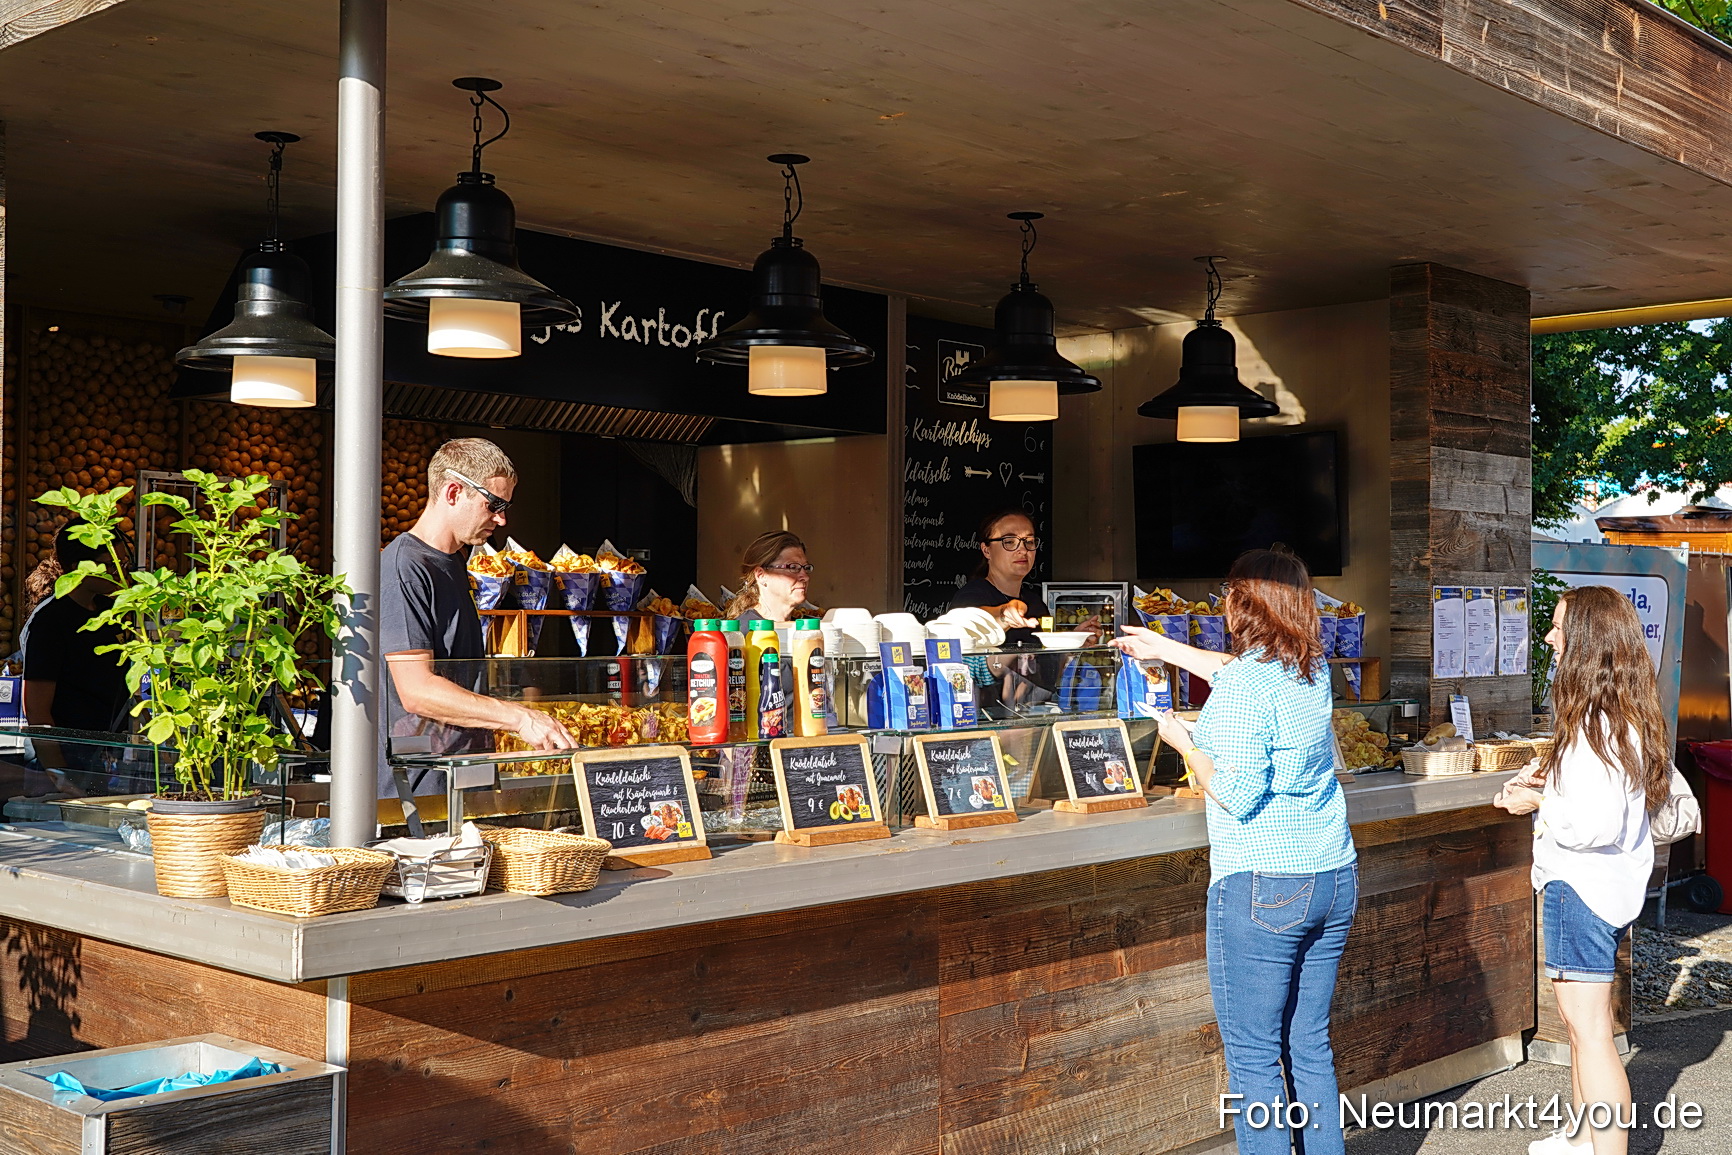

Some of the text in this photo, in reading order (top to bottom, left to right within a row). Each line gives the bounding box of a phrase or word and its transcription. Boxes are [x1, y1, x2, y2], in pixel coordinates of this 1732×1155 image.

[600, 300, 725, 348] Kartoff
[912, 417, 993, 453] Kartoffelchips
[1024, 426, 1037, 452] 6
[904, 455, 952, 486] ldatschi
[1021, 490, 1036, 516] 6
[904, 510, 945, 530] äuterquark
[904, 532, 945, 551] äuterquark
[904, 553, 935, 572] acamole
[904, 592, 931, 619] linos
[1624, 588, 1651, 613] la,
[595, 765, 652, 787] Knödeldatschi
[613, 788, 625, 801] mit
[626, 784, 672, 801] Kräuterquark
[948, 787, 962, 801] 7 €
[600, 798, 647, 817] Räucherlachs
[808, 797, 824, 813] 9 €
[611, 821, 636, 840] 10 €
